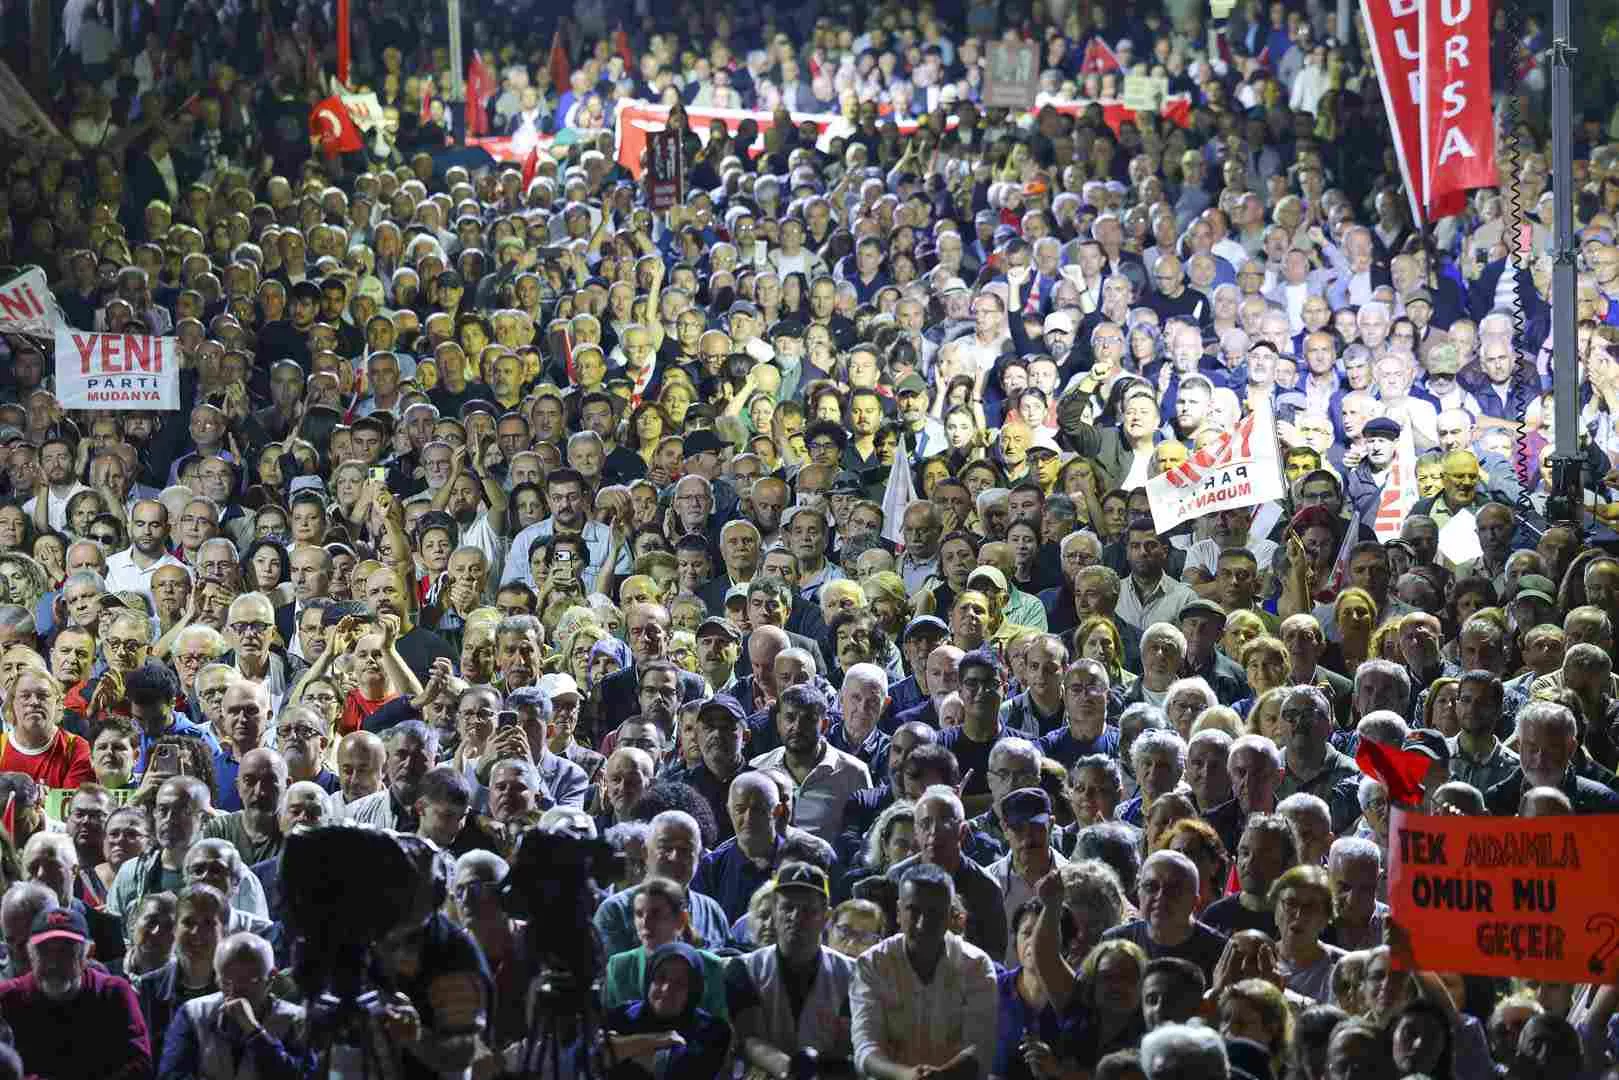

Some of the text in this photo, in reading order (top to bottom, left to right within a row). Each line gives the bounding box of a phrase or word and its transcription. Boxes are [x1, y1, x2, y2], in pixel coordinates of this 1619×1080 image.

[72, 334, 163, 375] YENİ
[87, 377, 159, 389] PARTİ
[87, 391, 161, 401] MUDANYA
[1398, 828, 1582, 870] TEK ADAMLA
[1511, 877, 1557, 912] MU
[1476, 920, 1566, 960] GEÇER
